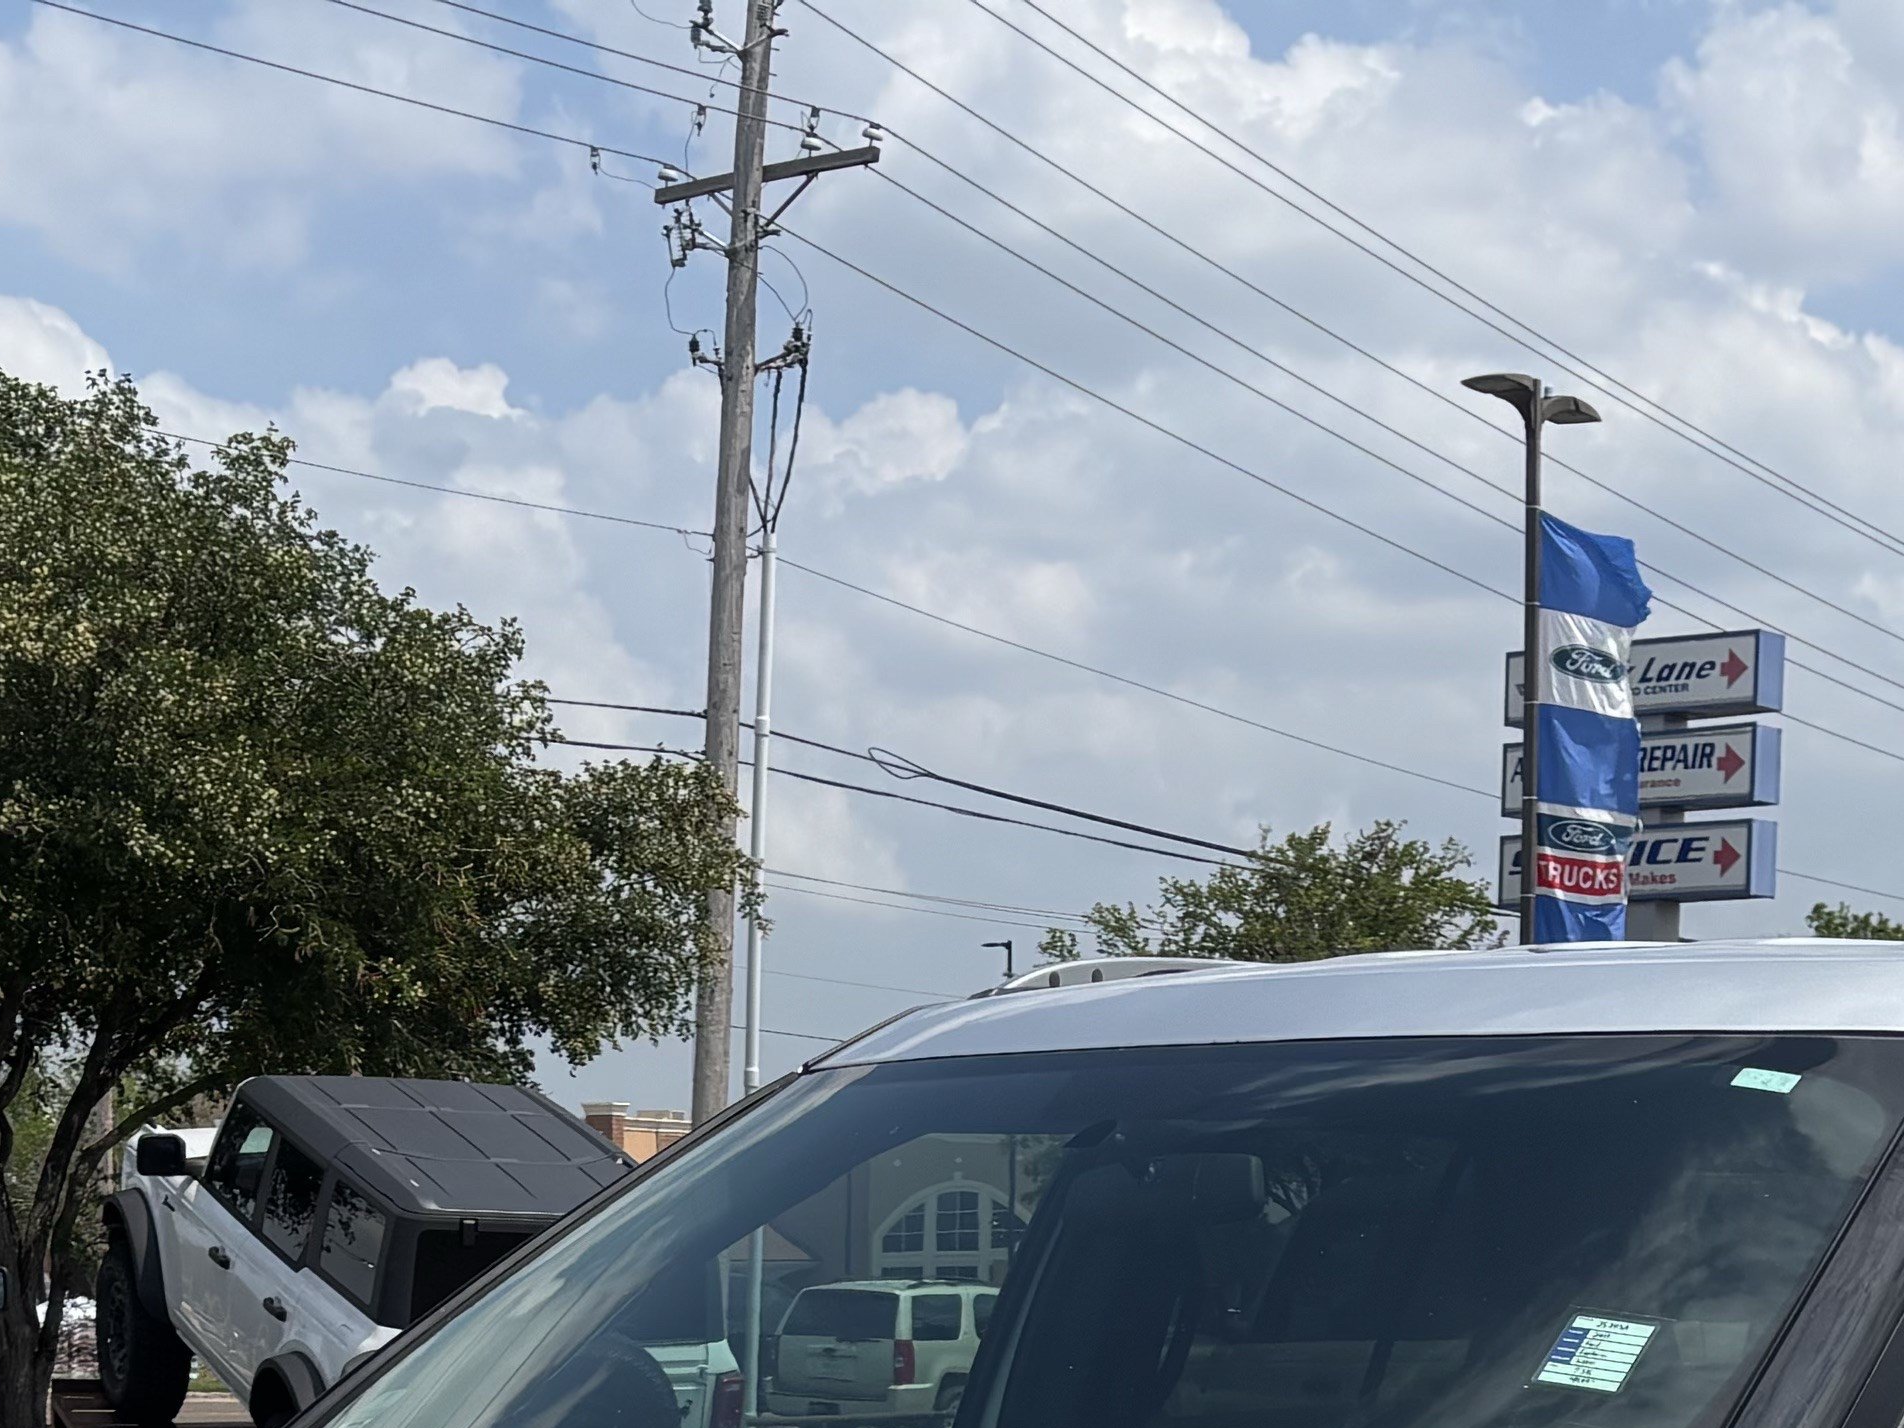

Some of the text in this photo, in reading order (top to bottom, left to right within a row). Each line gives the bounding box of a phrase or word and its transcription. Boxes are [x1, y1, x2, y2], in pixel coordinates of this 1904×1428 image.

[1565, 649, 1615, 679] Ford
[1638, 655, 1716, 684] Lane
[1643, 683, 1690, 696] CENTER
[1539, 859, 1619, 889] TRUCKS
